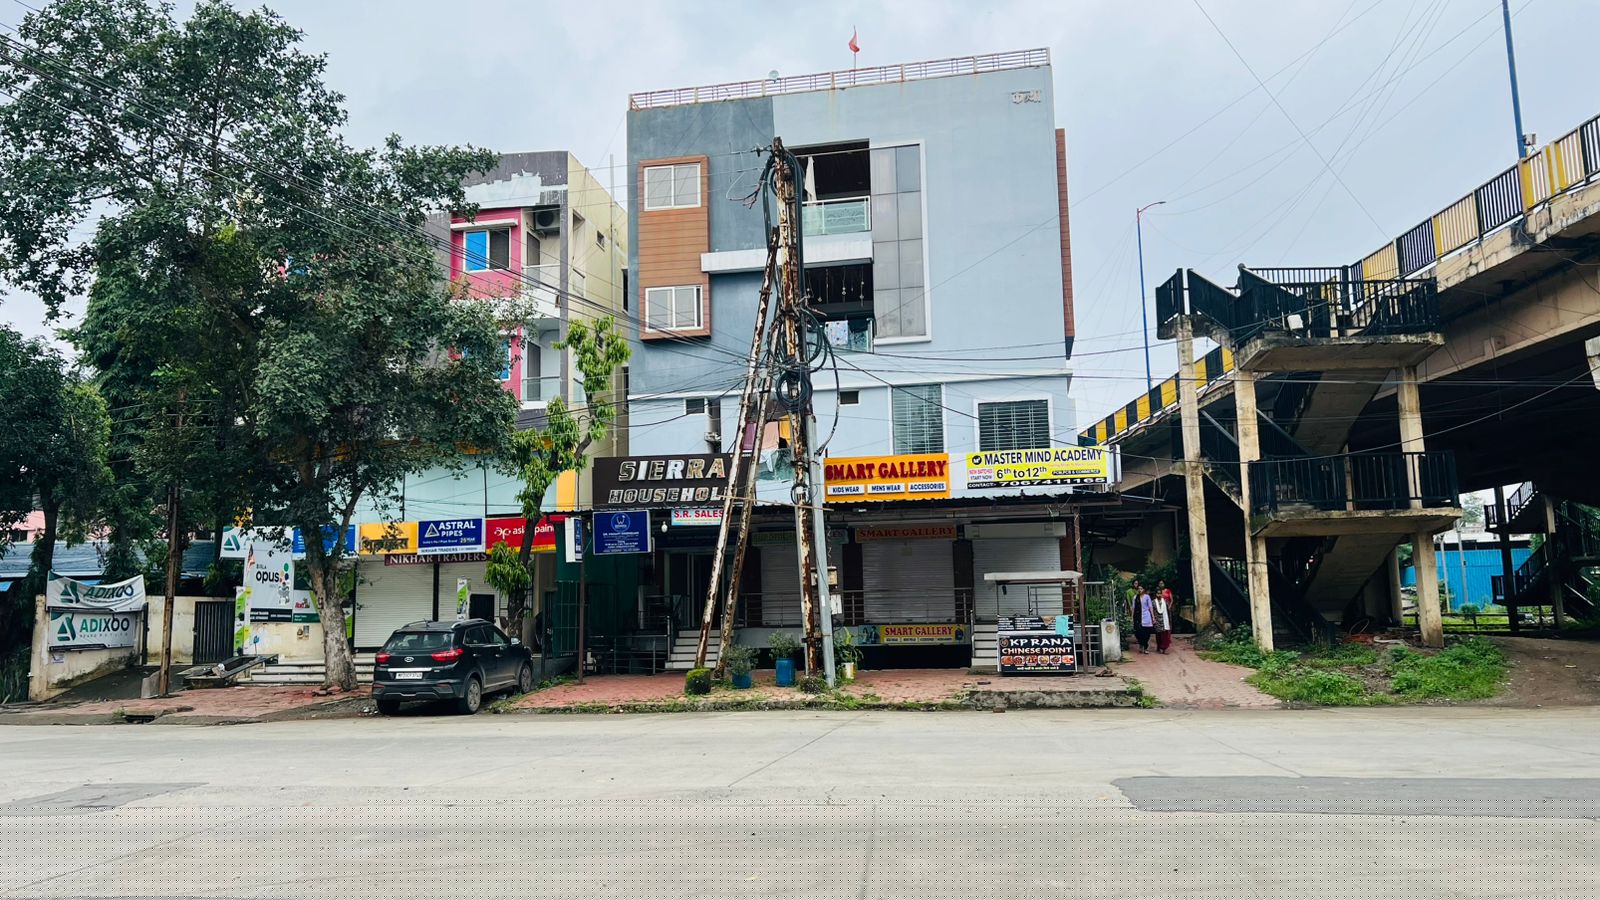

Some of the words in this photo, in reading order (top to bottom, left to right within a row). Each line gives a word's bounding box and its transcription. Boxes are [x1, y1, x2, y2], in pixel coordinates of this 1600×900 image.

[984, 451, 1022, 465] MASTER
[1025, 450, 1052, 463] MIND
[1054, 448, 1102, 462] ACADEMY
[618, 458, 726, 482] SIERRA
[825, 463, 875, 480] SMART
[878, 460, 947, 479] GALLERY
[997, 468, 1012, 479] 6th
[608, 487, 728, 504] HOUSEHOL
[674, 510, 692, 518] S.R.
[694, 510, 724, 518] SALES
[438, 520, 476, 530] ASTRAL
[860, 528, 899, 538] SMART
[902, 526, 954, 537] GALLERY
[390, 554, 433, 564] NIKHAR
[437, 552, 487, 562] TRADERS
[256, 570, 280, 584] opus
[84, 584, 134, 599] ADIXOO
[80, 617, 130, 632] ADIXOO
[885, 627, 913, 636] SMART
[916, 627, 953, 635] GALLERY
[1009, 638, 1028, 646] KP
[1031, 638, 1071, 646] RANA
[1002, 647, 1040, 655] CHINESE
